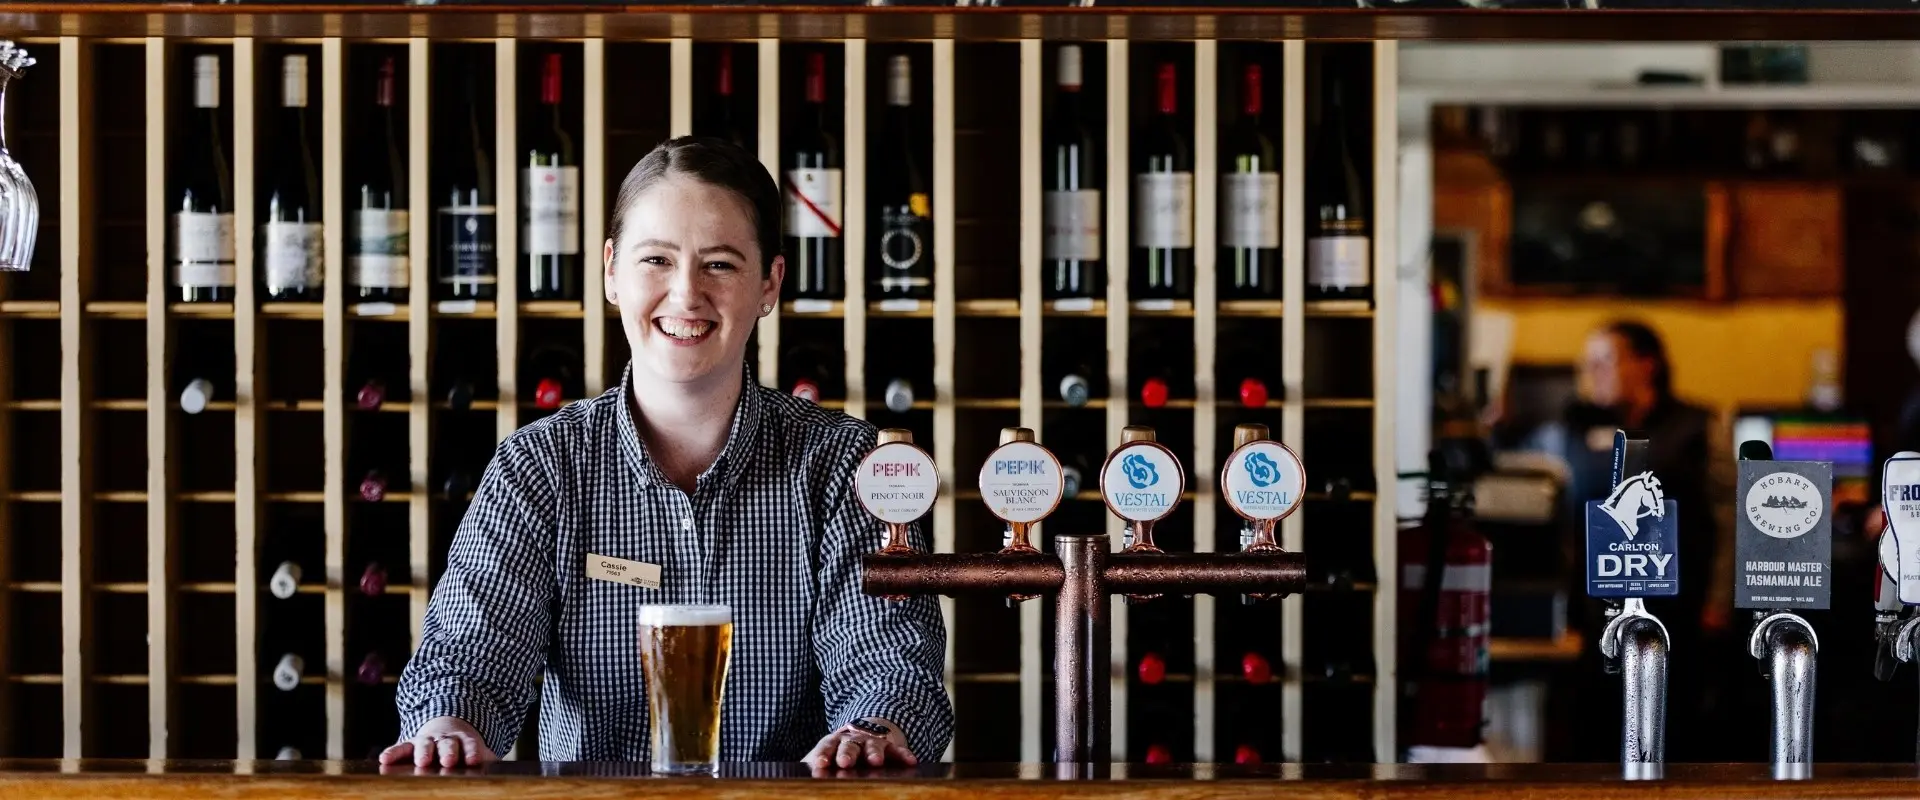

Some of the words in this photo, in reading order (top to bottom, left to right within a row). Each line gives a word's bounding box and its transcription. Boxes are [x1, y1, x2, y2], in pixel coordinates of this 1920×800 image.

[872, 463, 921, 477] PEPIK
[995, 460, 1045, 475] PEPIK
[1760, 476, 1809, 491] HOBART
[871, 492, 900, 500] PINOT
[901, 492, 925, 500] NOIR
[993, 488, 1049, 497] SAUVIGNON
[1236, 490, 1292, 505] VESTAL
[1005, 496, 1037, 504] BLANC
[1115, 492, 1170, 507] VESTAL
[1750, 506, 1801, 534] BREWING
[1608, 542, 1659, 552] CARLTON
[600, 561, 627, 571] Cassie
[1597, 553, 1673, 577] DRY
[1745, 561, 1786, 572] HARBOUR
[1787, 561, 1822, 573] MASTER
[1745, 574, 1801, 587] TASMANIAN
[1802, 575, 1822, 587] ALE
